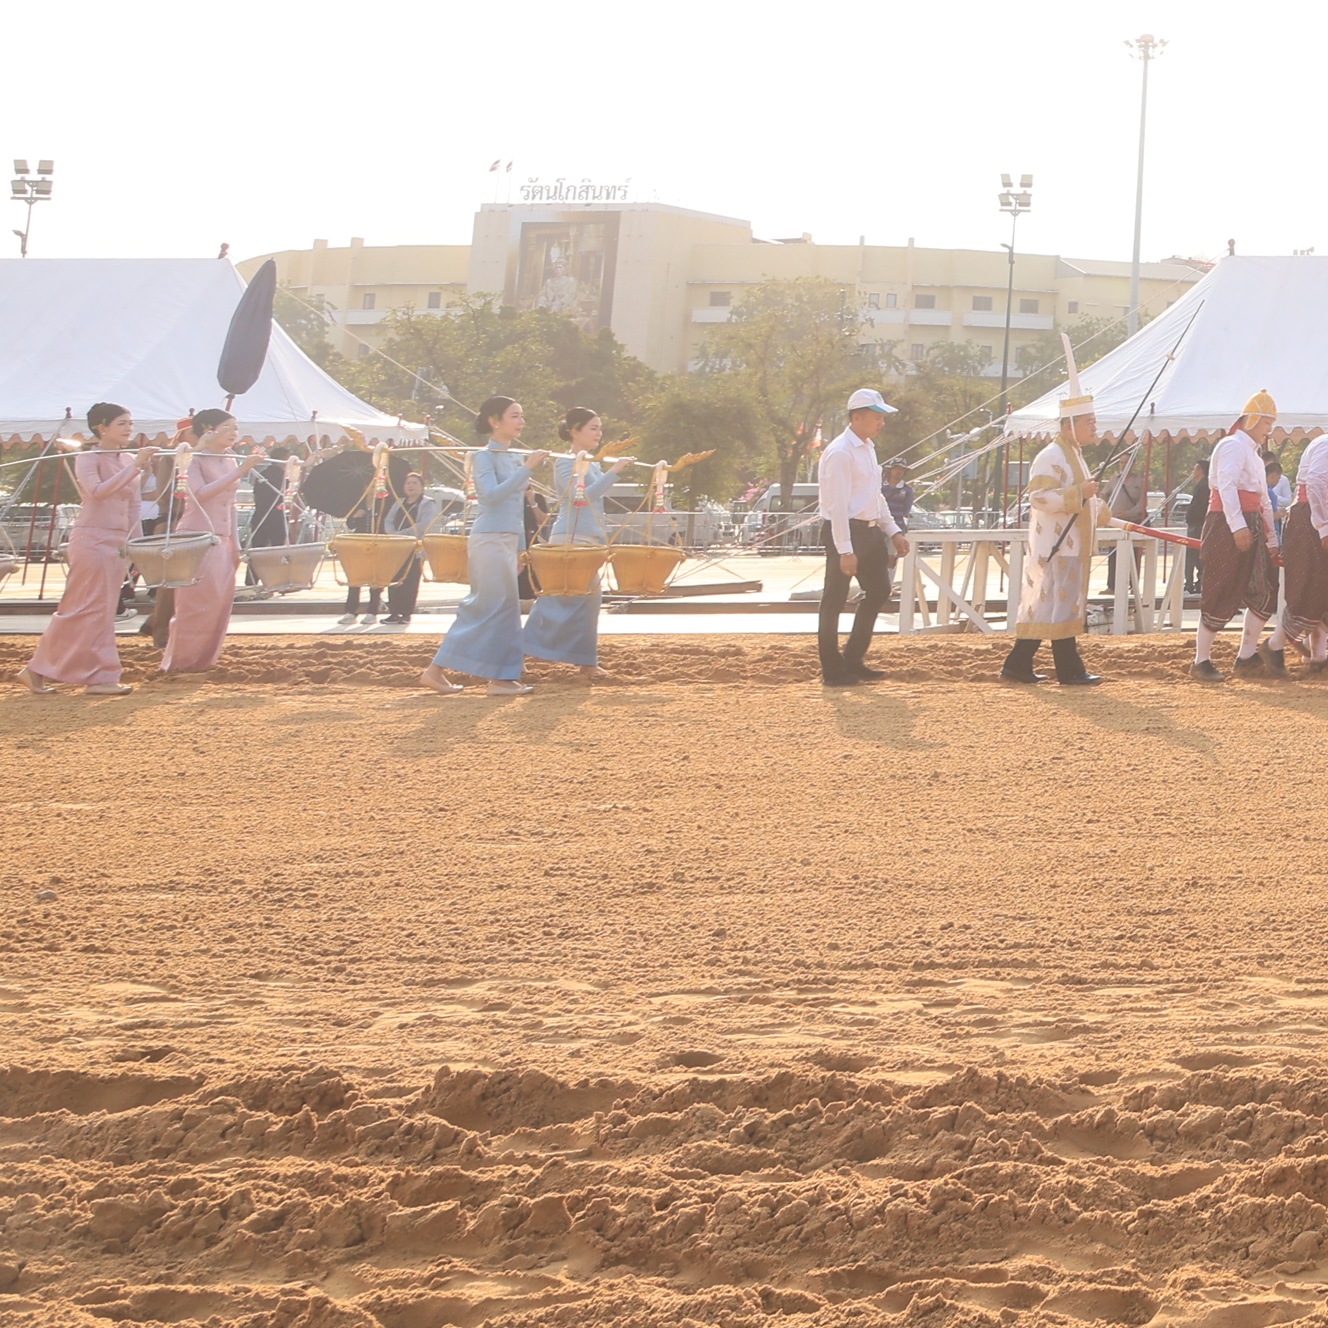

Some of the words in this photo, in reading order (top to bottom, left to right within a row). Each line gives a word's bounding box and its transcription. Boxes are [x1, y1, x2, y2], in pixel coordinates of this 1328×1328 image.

[520, 177, 632, 200] รัตนโกสินทร์
